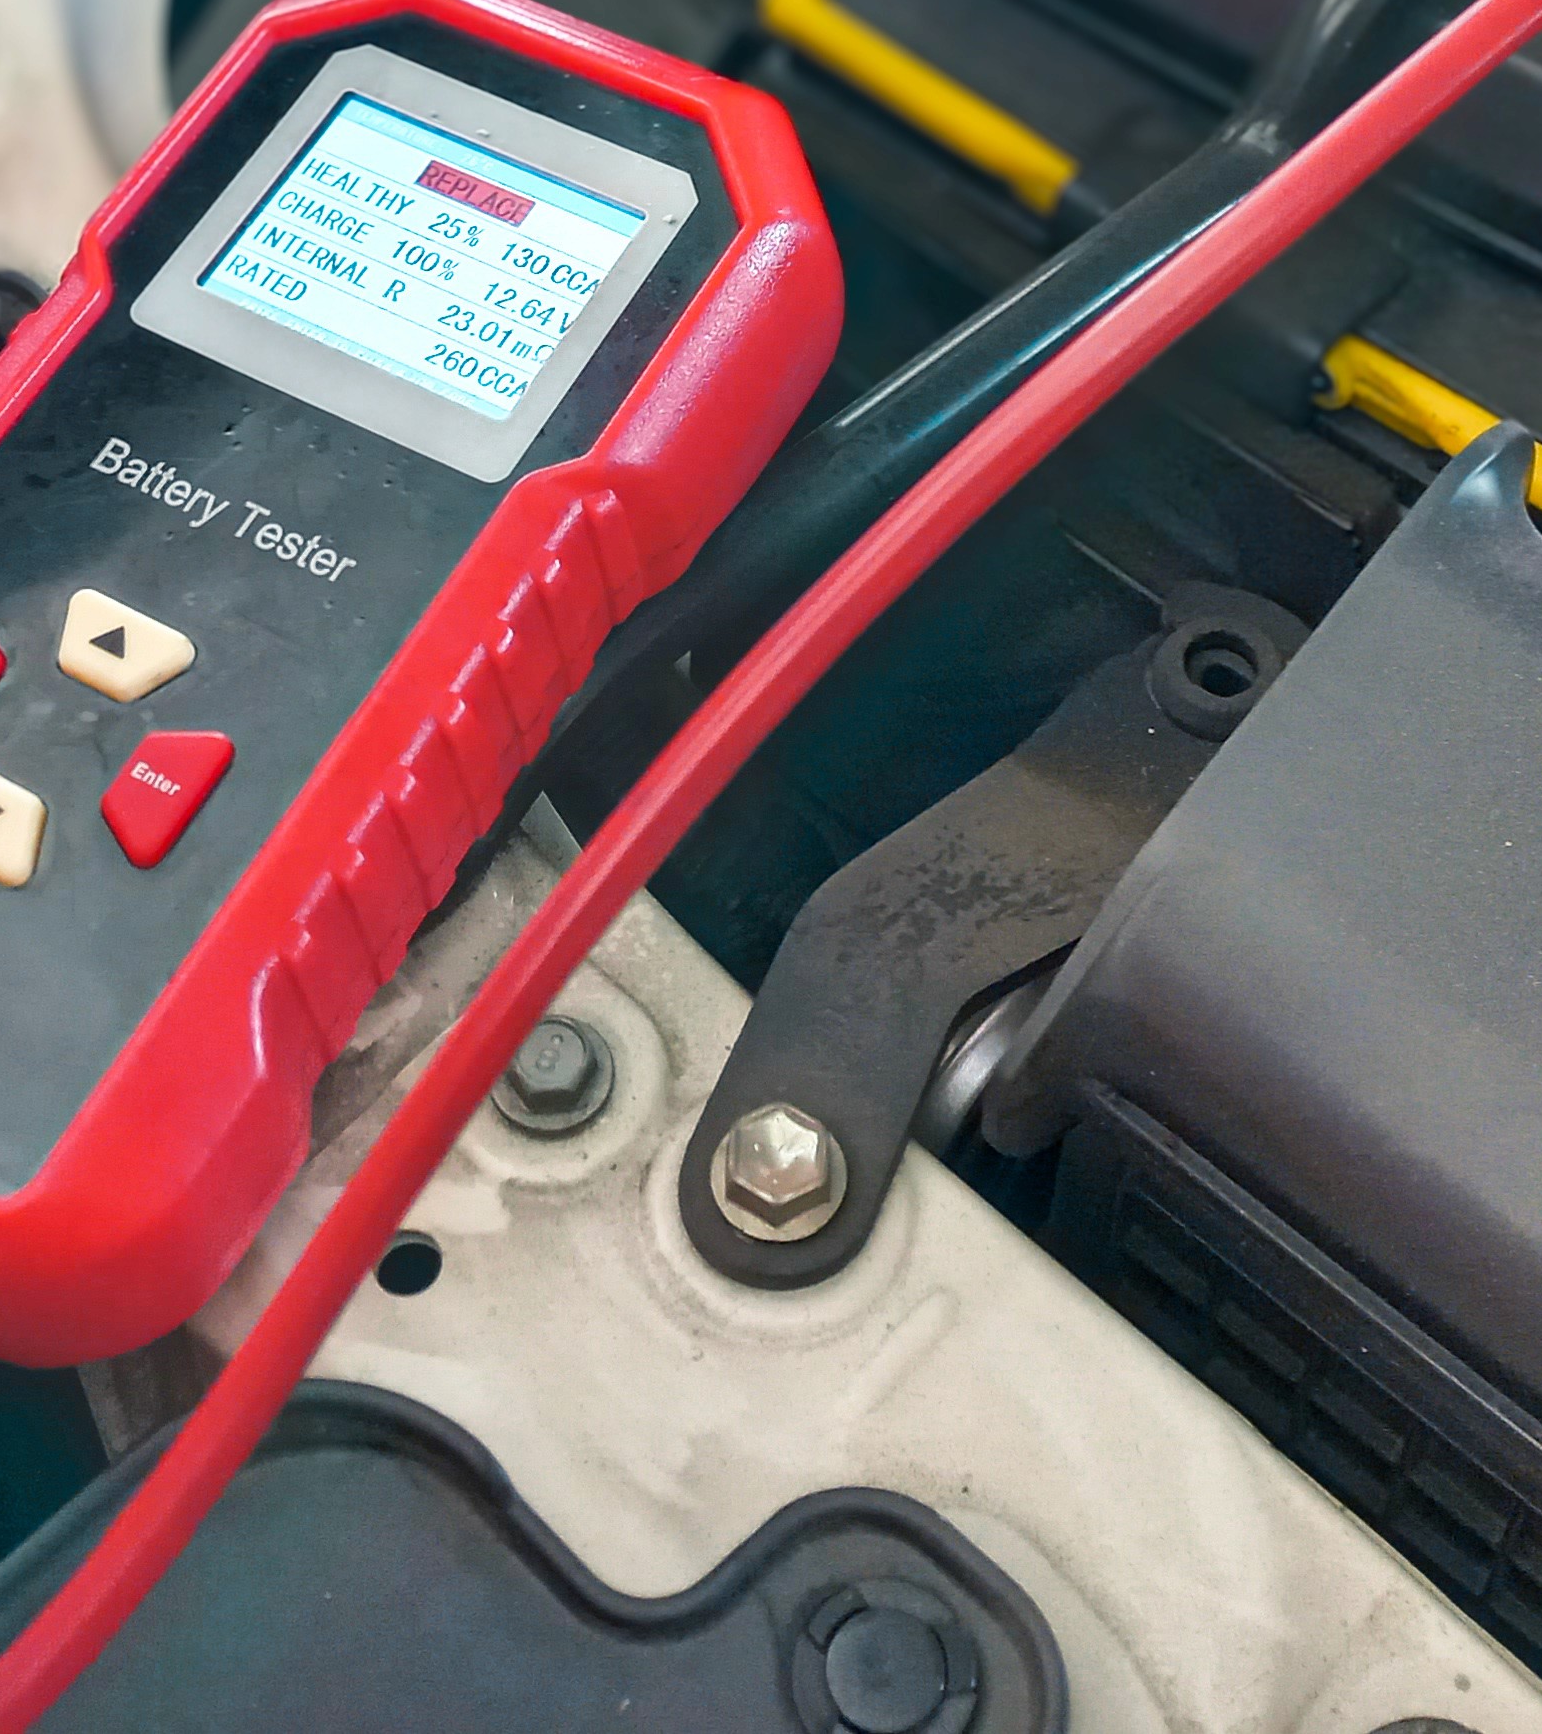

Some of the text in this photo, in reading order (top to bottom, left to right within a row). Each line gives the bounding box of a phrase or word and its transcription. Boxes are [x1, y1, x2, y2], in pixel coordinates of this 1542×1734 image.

[301, 157, 416, 216] HEALTHY
[427, 212, 485, 248] 25%
[417, 164, 535, 226] REPLACE
[252, 222, 368, 290] INTERNAL
[381, 279, 406, 302] R
[277, 190, 375, 244] CHARGE
[391, 239, 460, 282] 100%
[224, 254, 308, 302] RATED
[89, 436, 358, 583] Battery Tester
[129, 760, 182, 797] Enter
